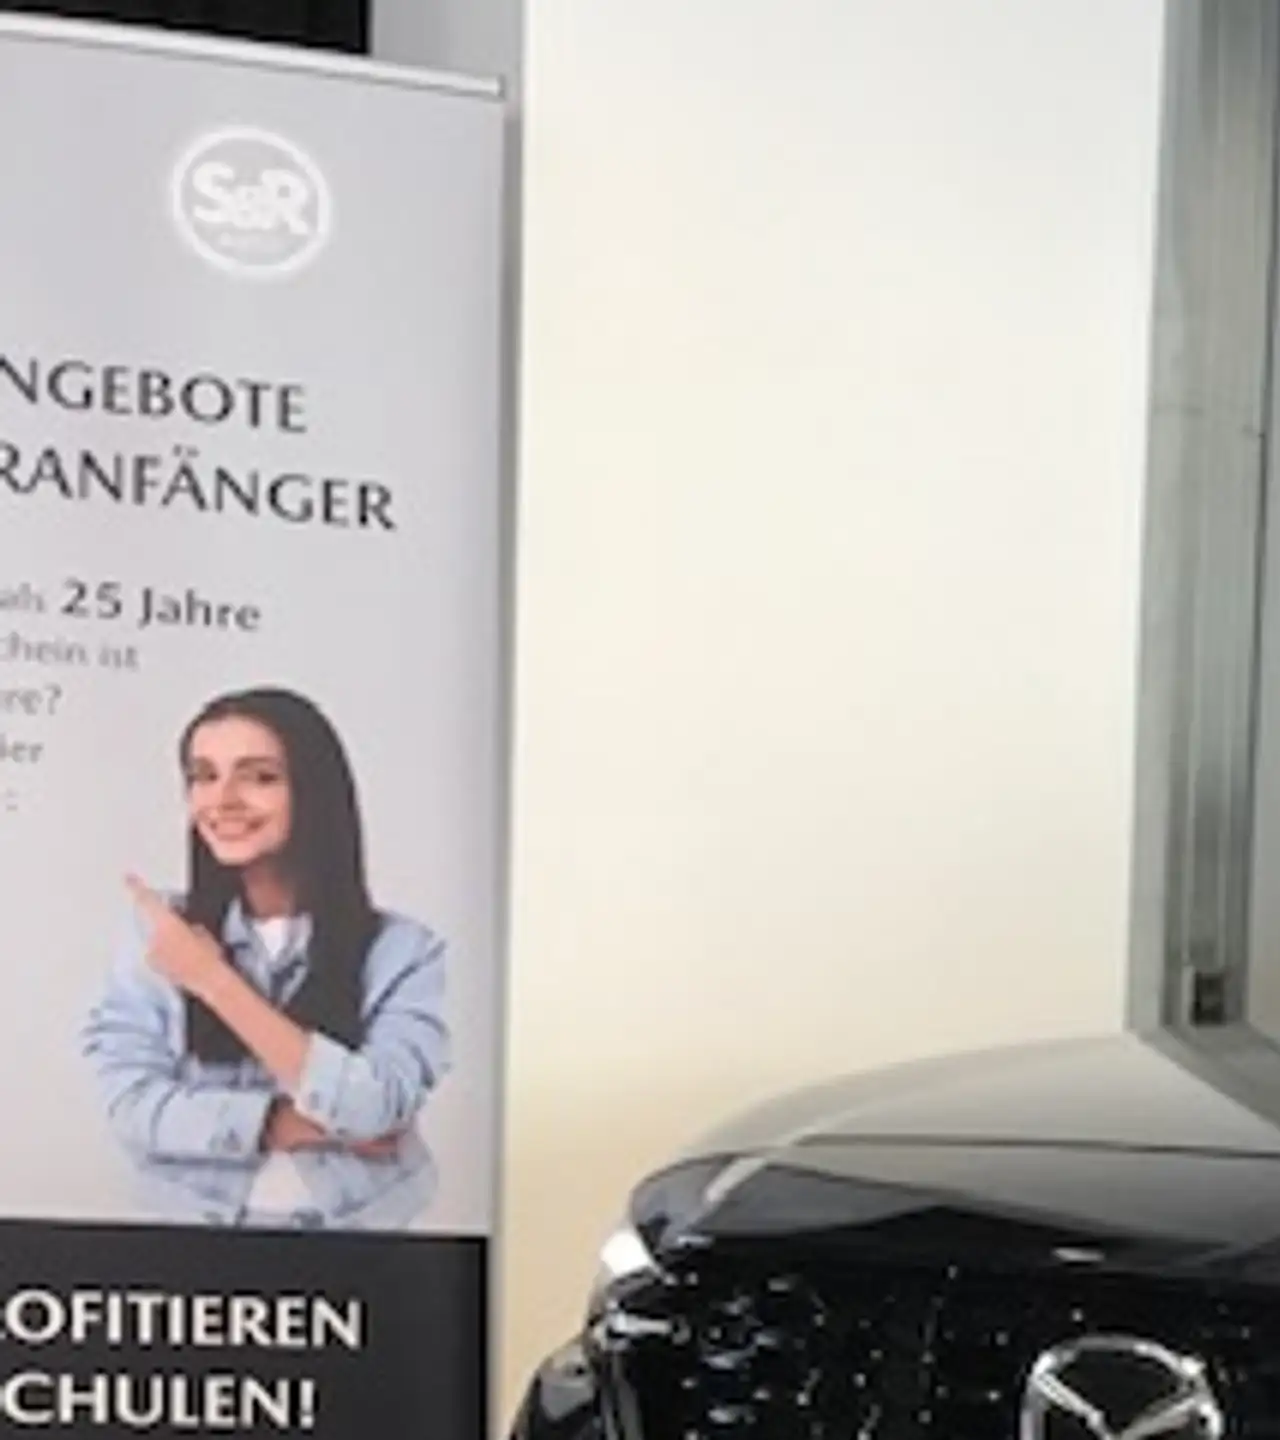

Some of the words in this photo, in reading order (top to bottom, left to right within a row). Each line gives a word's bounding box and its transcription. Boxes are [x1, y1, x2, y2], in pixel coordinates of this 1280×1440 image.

[61, 576, 122, 620] 25
[137, 586, 262, 632] Jahre
[0, 1289, 363, 1350] OFITIEREN
[0, 1371, 315, 1430] CHULEN!
